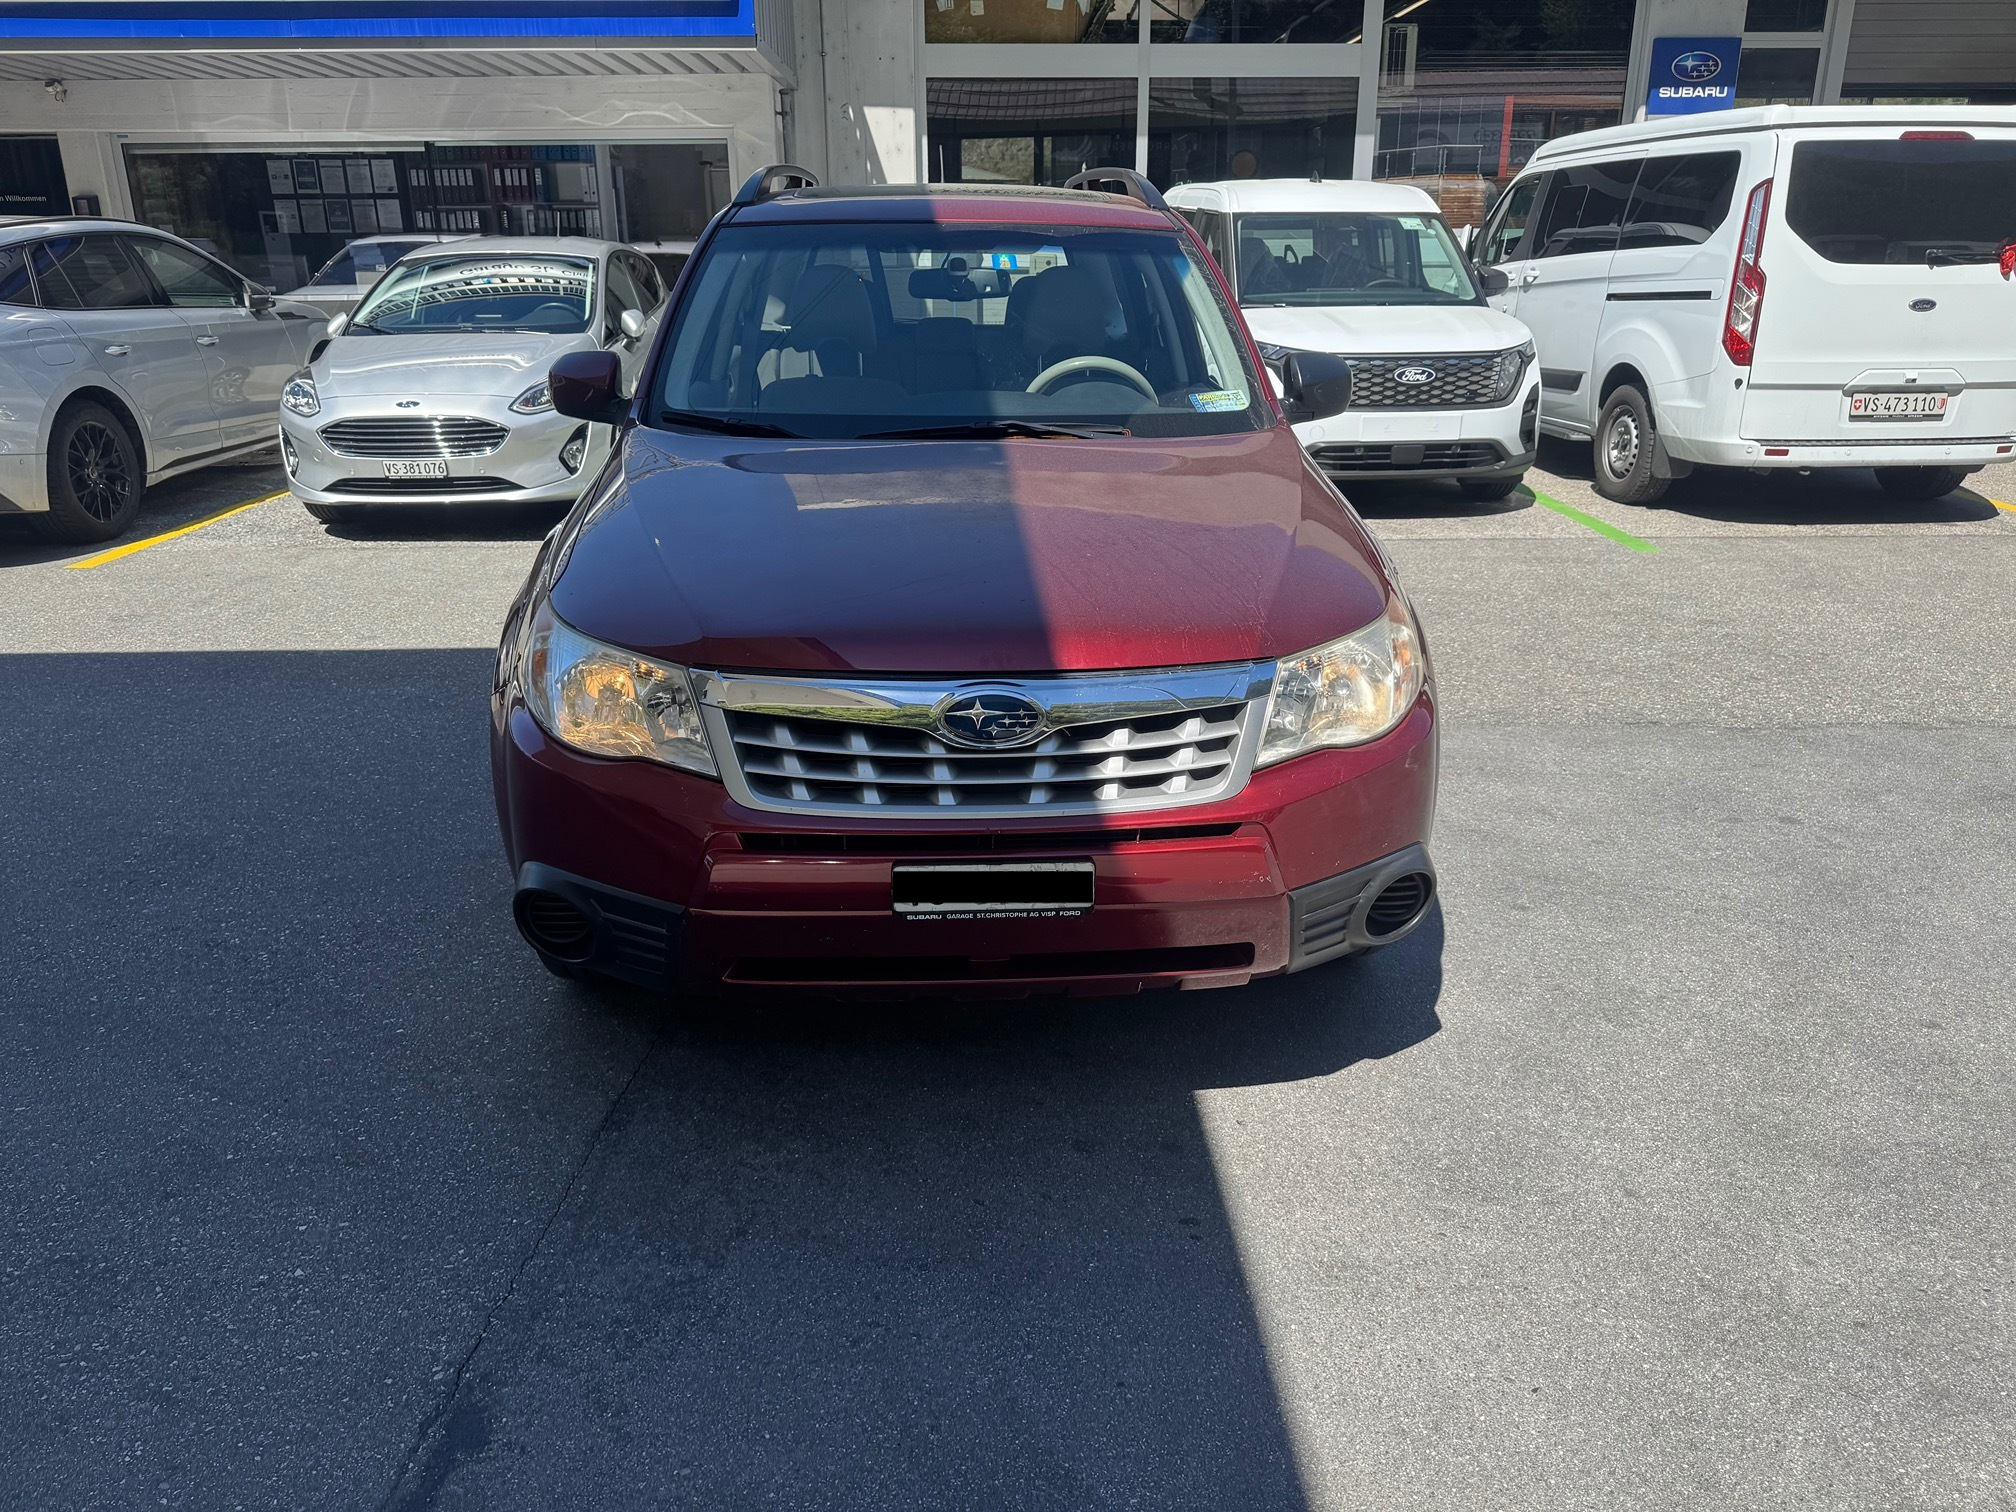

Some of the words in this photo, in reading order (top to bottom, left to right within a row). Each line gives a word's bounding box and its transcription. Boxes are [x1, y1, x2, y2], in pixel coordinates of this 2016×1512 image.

[1658, 85, 1728, 98] SUBARU
[4, 194, 47, 202] Willkommen
[976, 911, 1028, 919] ST.CHRISTOPHE
